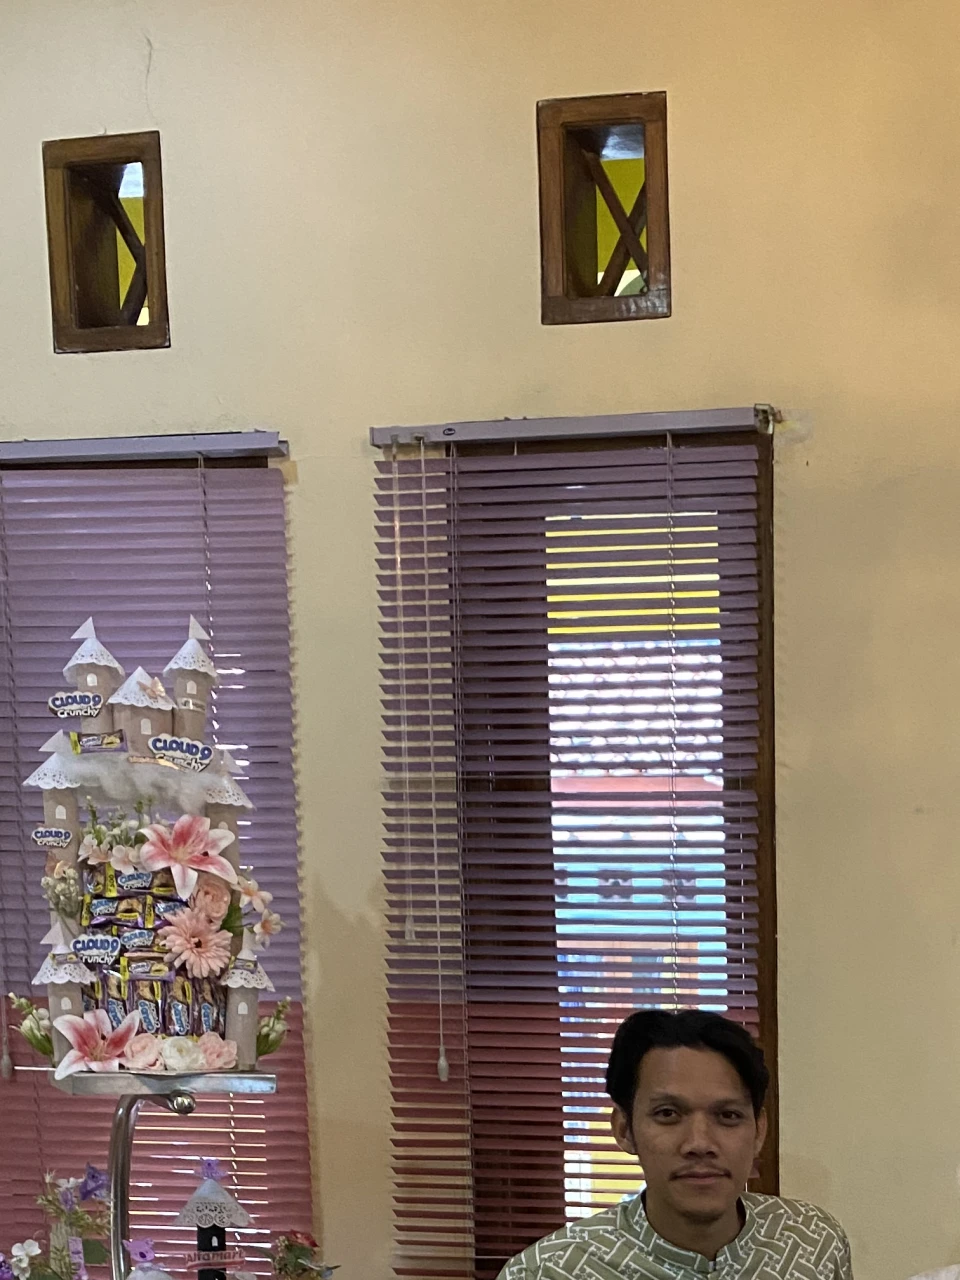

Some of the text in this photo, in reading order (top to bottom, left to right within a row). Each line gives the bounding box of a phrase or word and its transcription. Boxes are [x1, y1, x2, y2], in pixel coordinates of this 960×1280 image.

[51, 694, 101, 707] CLOUD 9
[57, 706, 100, 718] Crunchy
[151, 737, 213, 761] CLOUD 9
[34, 830, 63, 840] CLOUD
[72, 938, 119, 953] CLOUD 9
